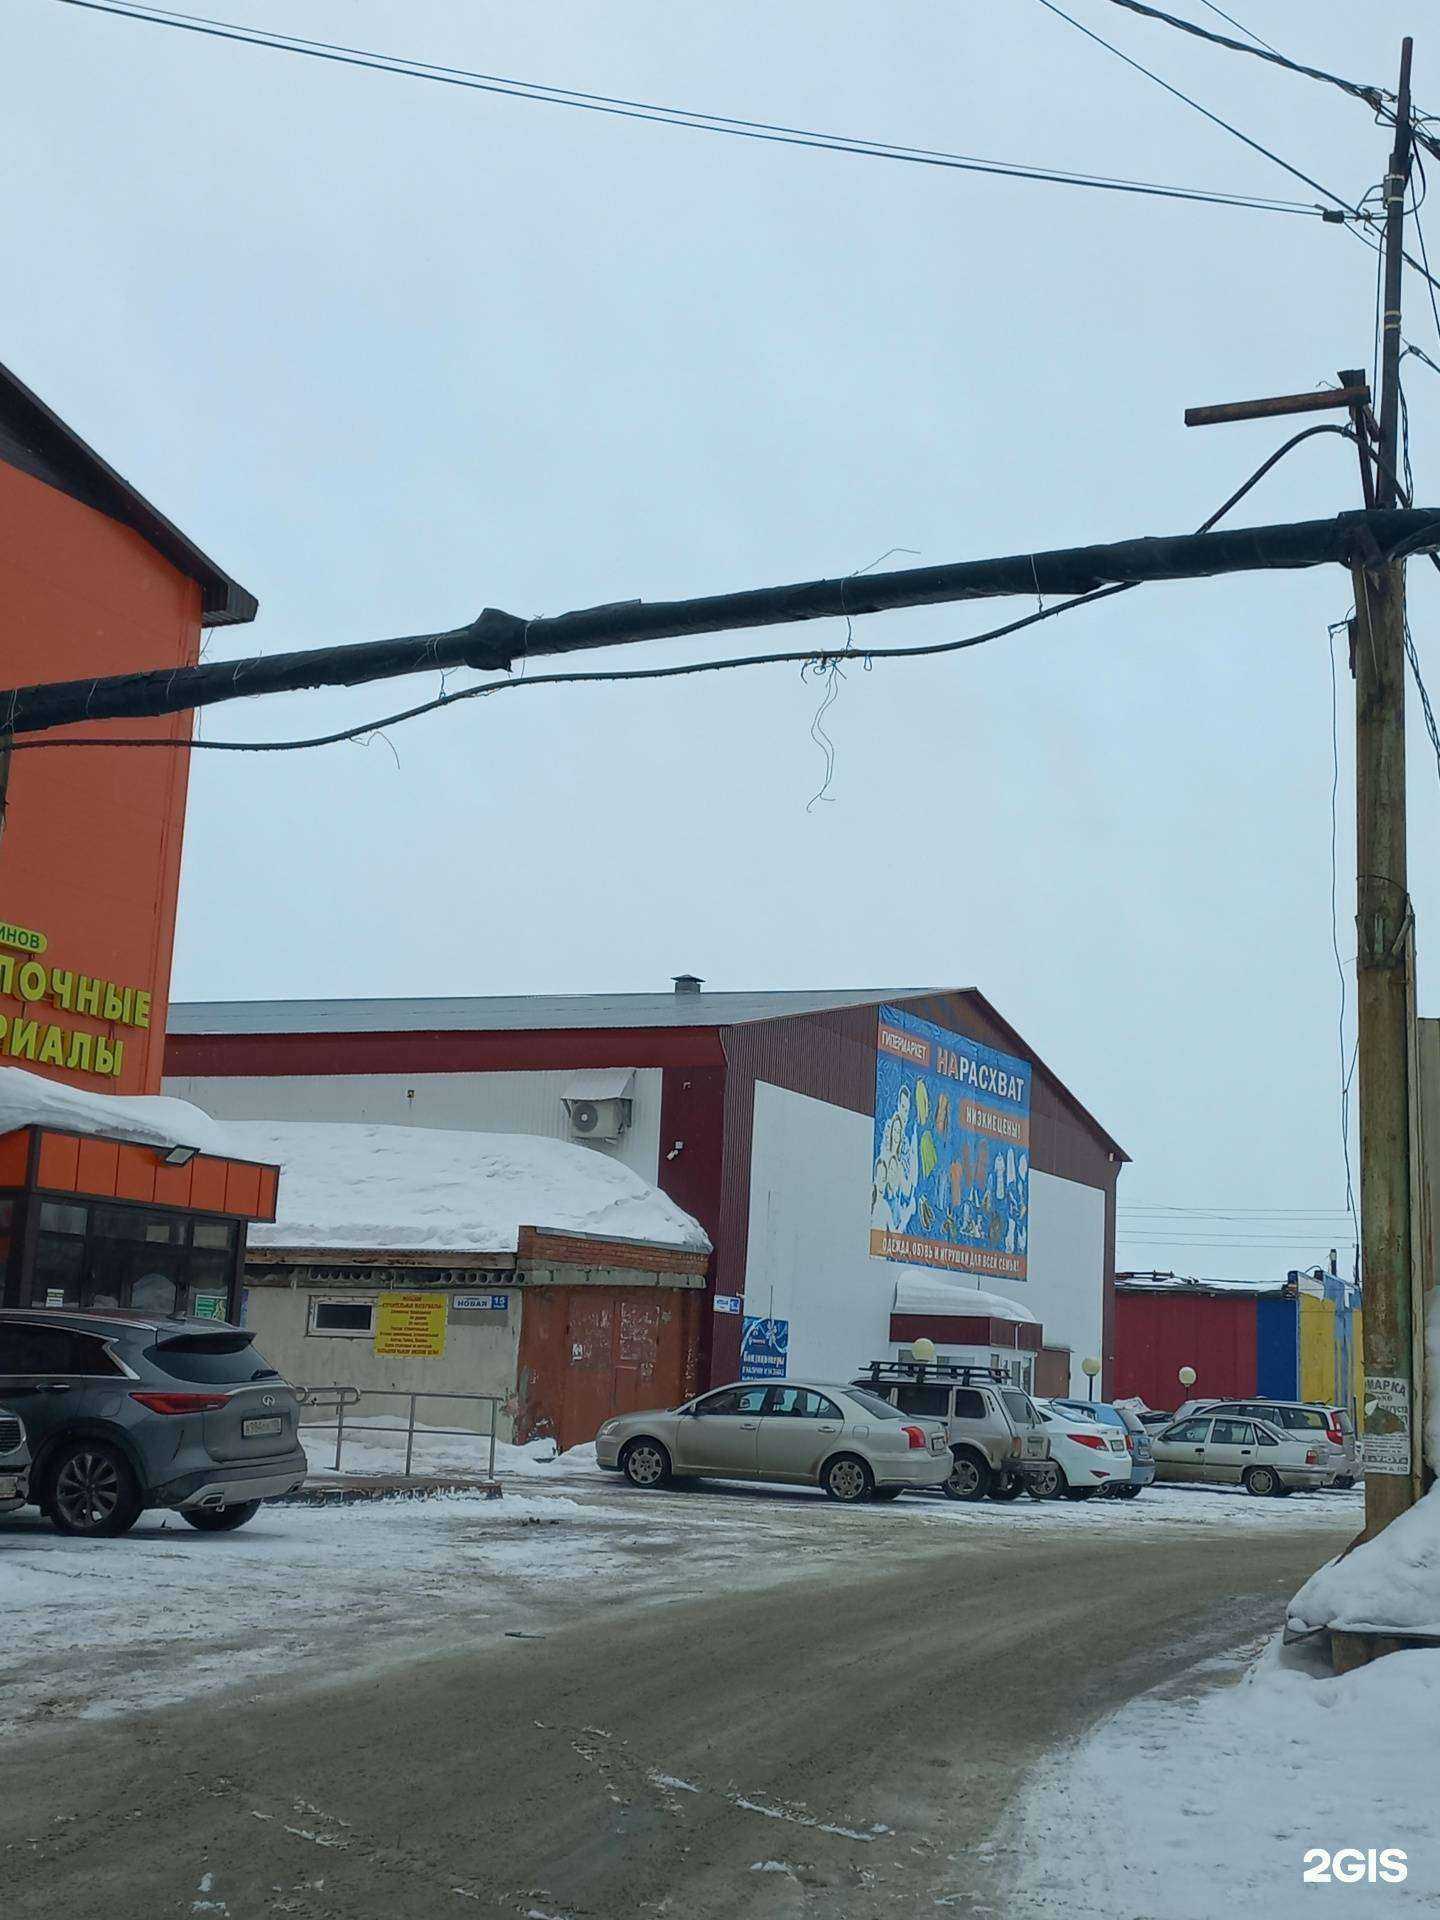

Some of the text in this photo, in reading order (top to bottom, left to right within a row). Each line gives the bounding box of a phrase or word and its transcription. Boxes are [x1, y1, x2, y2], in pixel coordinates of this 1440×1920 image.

[881, 1030, 927, 1060] ГИПЕРМАРКЕТ
[936, 1046, 1025, 1102] НАРАСХВАТ
[457, 1299, 487, 1307] НОВАЯ
